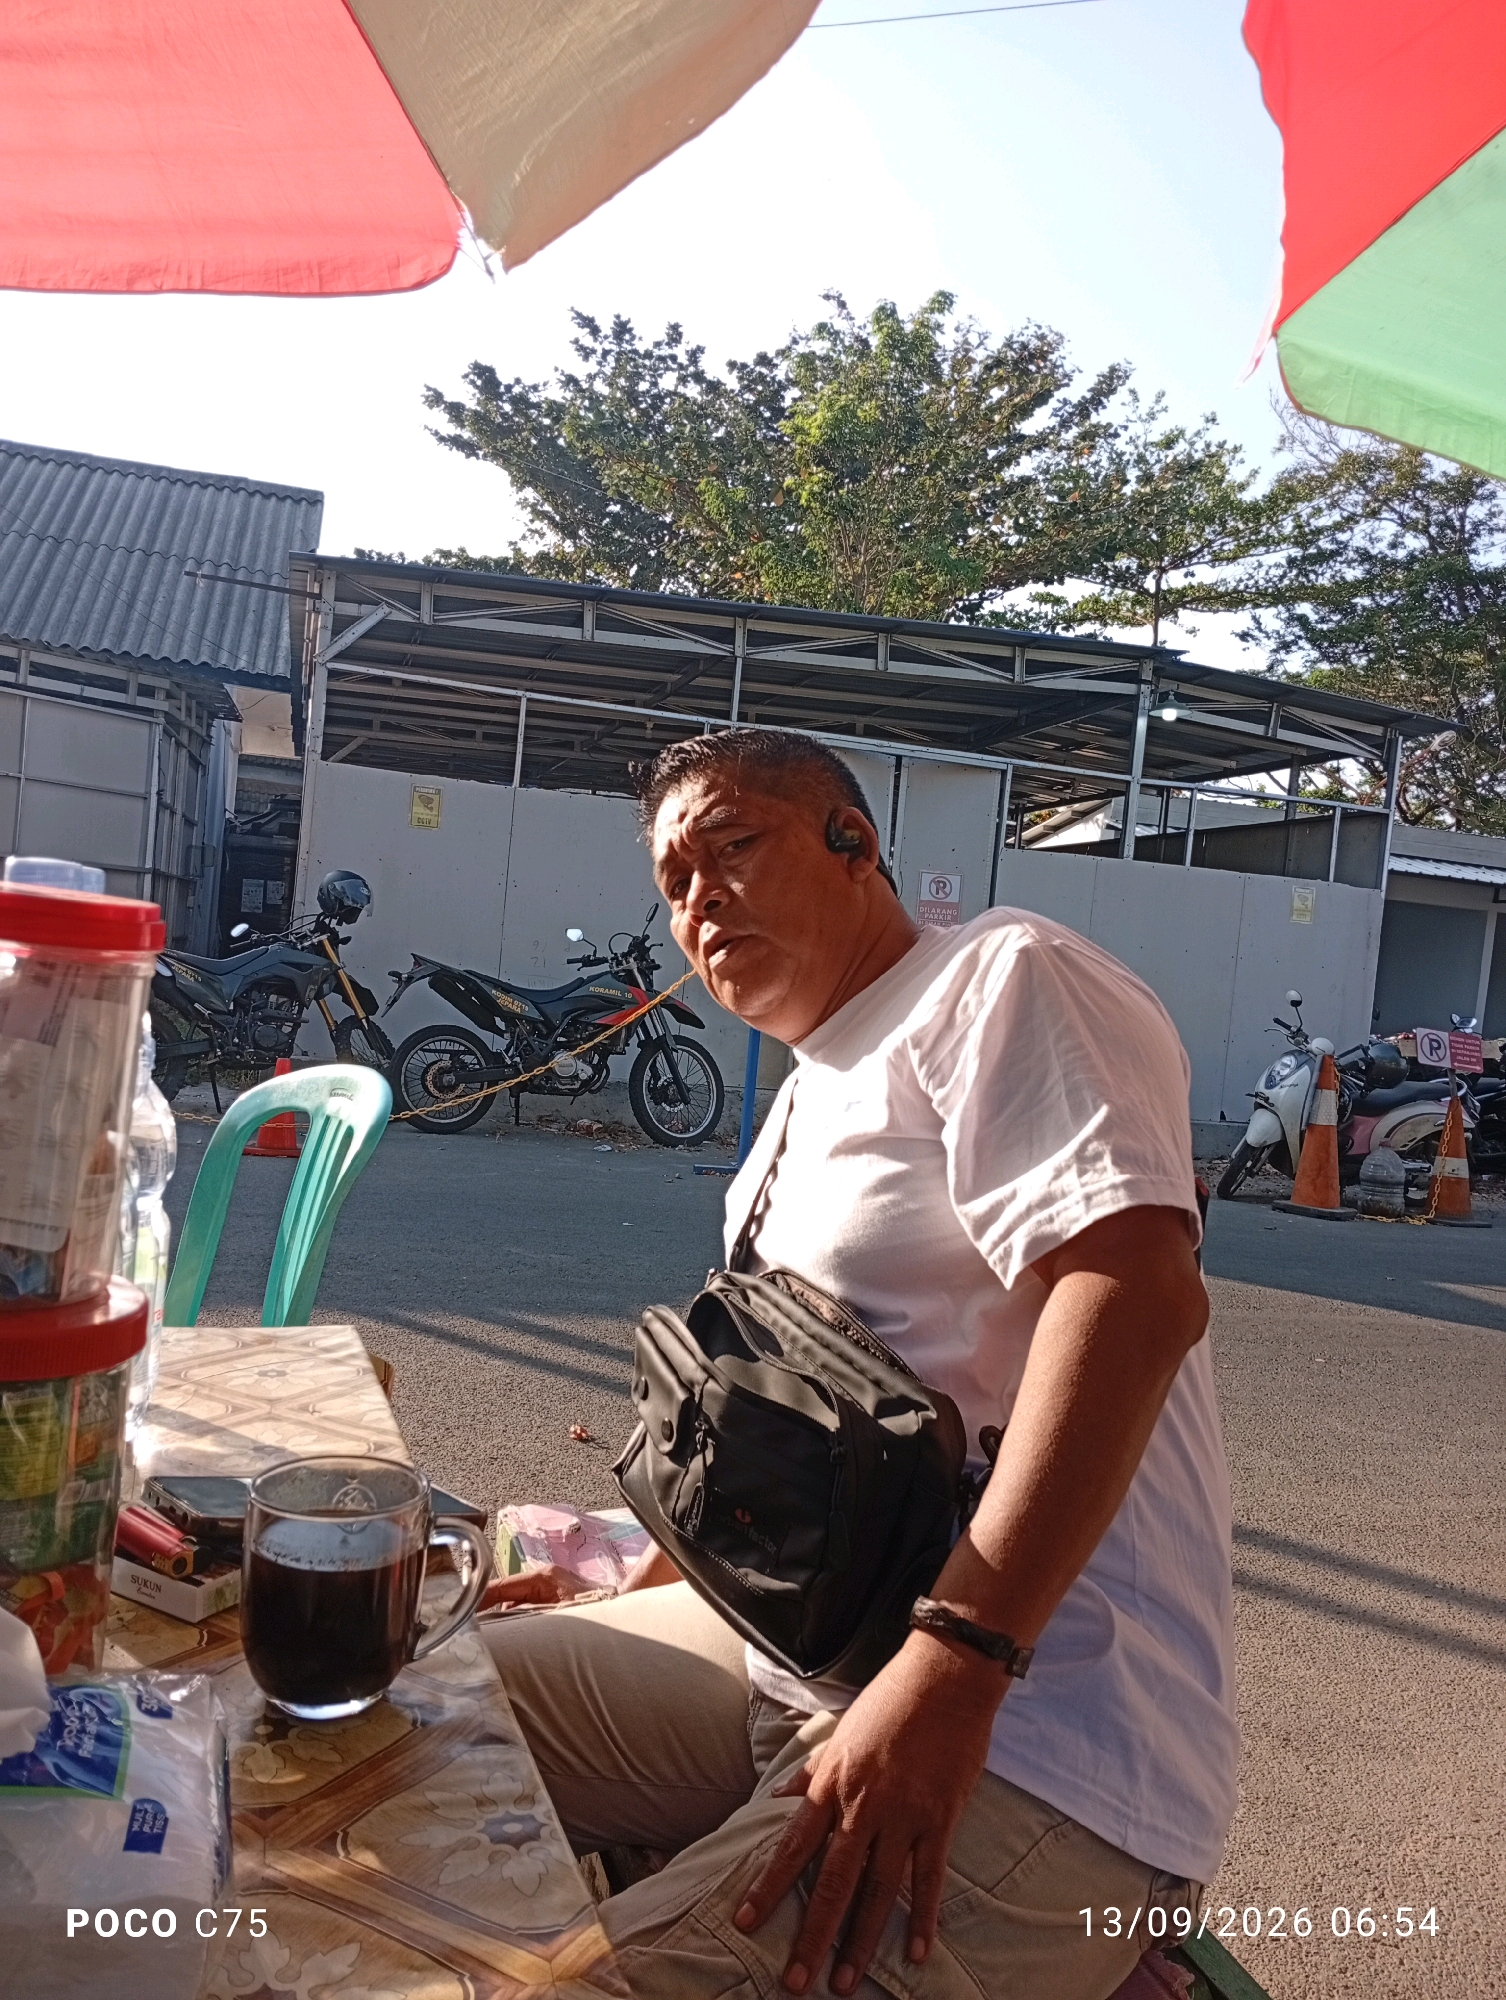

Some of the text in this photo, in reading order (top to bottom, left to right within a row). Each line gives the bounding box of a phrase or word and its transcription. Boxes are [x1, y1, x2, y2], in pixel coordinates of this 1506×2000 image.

[919, 906, 957, 916] DILARANG
[924, 912, 952, 921] PARKIR
[491, 989, 513, 1003] KODIM
[589, 986, 622, 996] KORAMIL
[496, 998, 521, 1013] JEPARA
[130, 1574, 162, 1594] SUKUN
